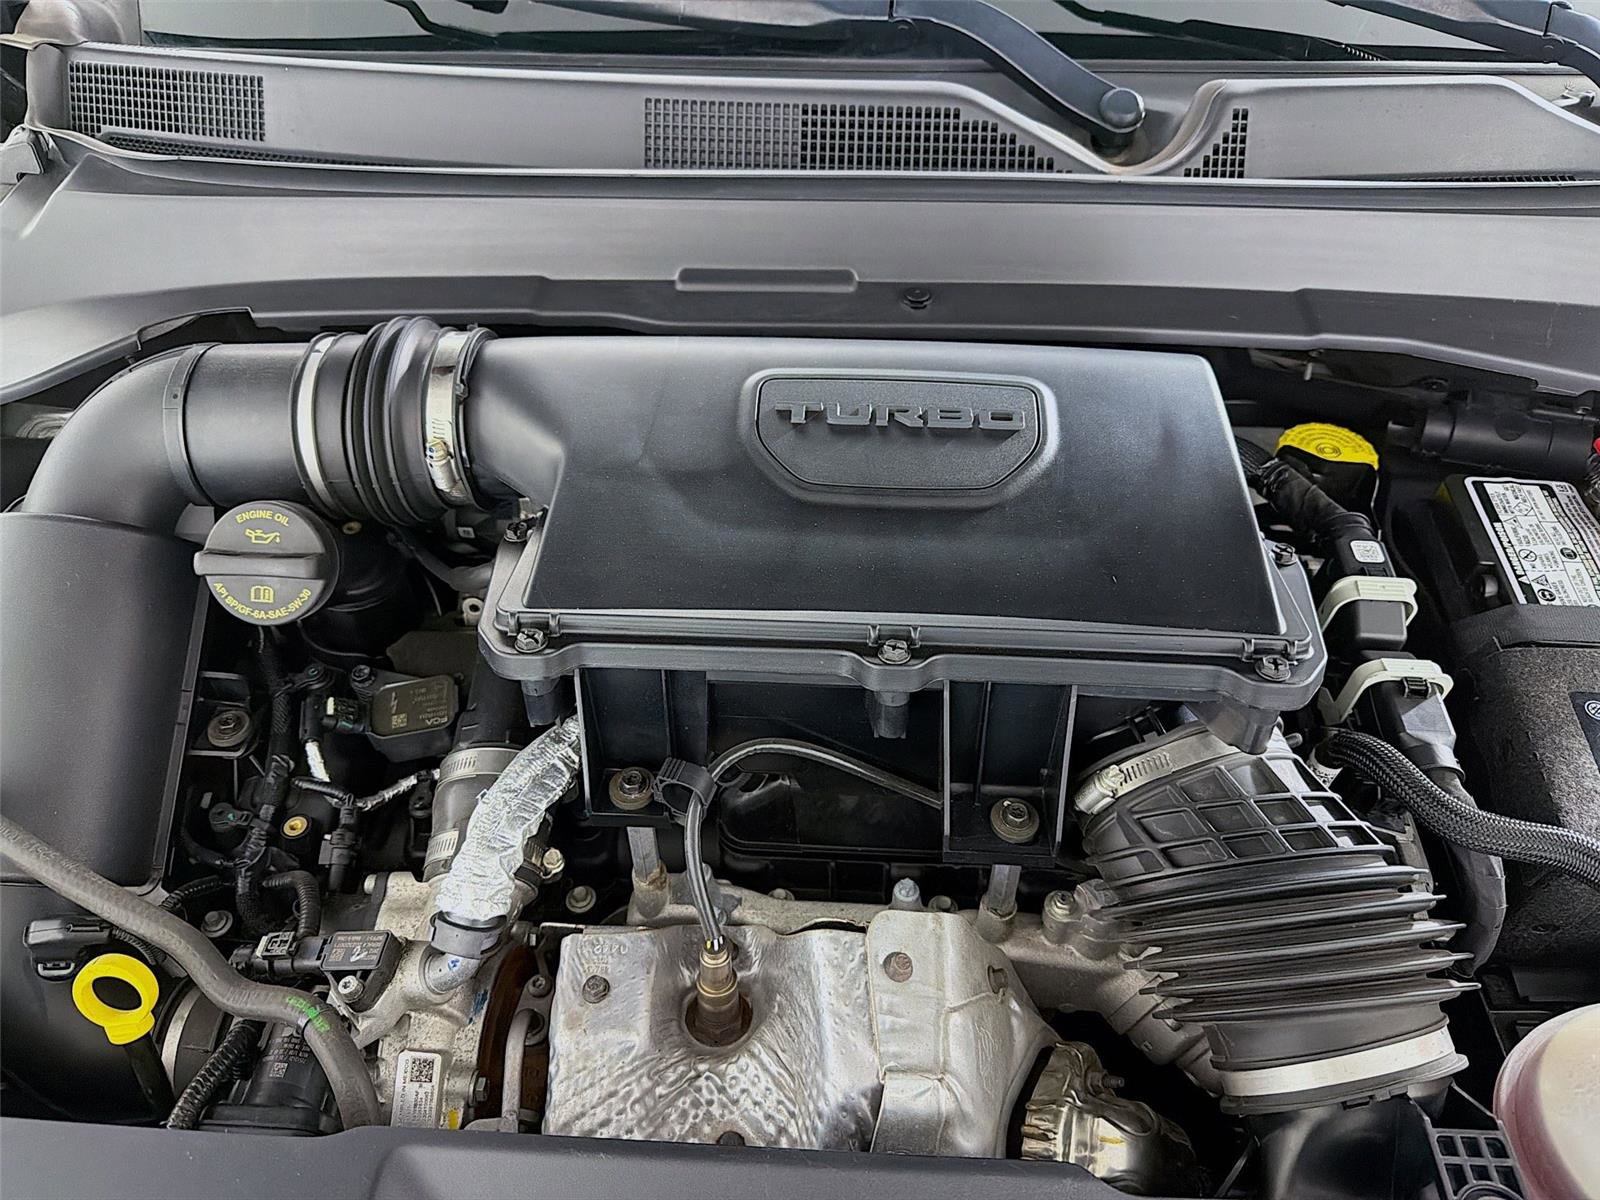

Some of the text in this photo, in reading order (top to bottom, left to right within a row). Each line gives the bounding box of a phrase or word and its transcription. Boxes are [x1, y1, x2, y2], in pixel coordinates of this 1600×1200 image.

[775, 401, 1025, 430] TURBO
[236, 510, 290, 527] ENGINE OIL
[213, 581, 227, 598] API
